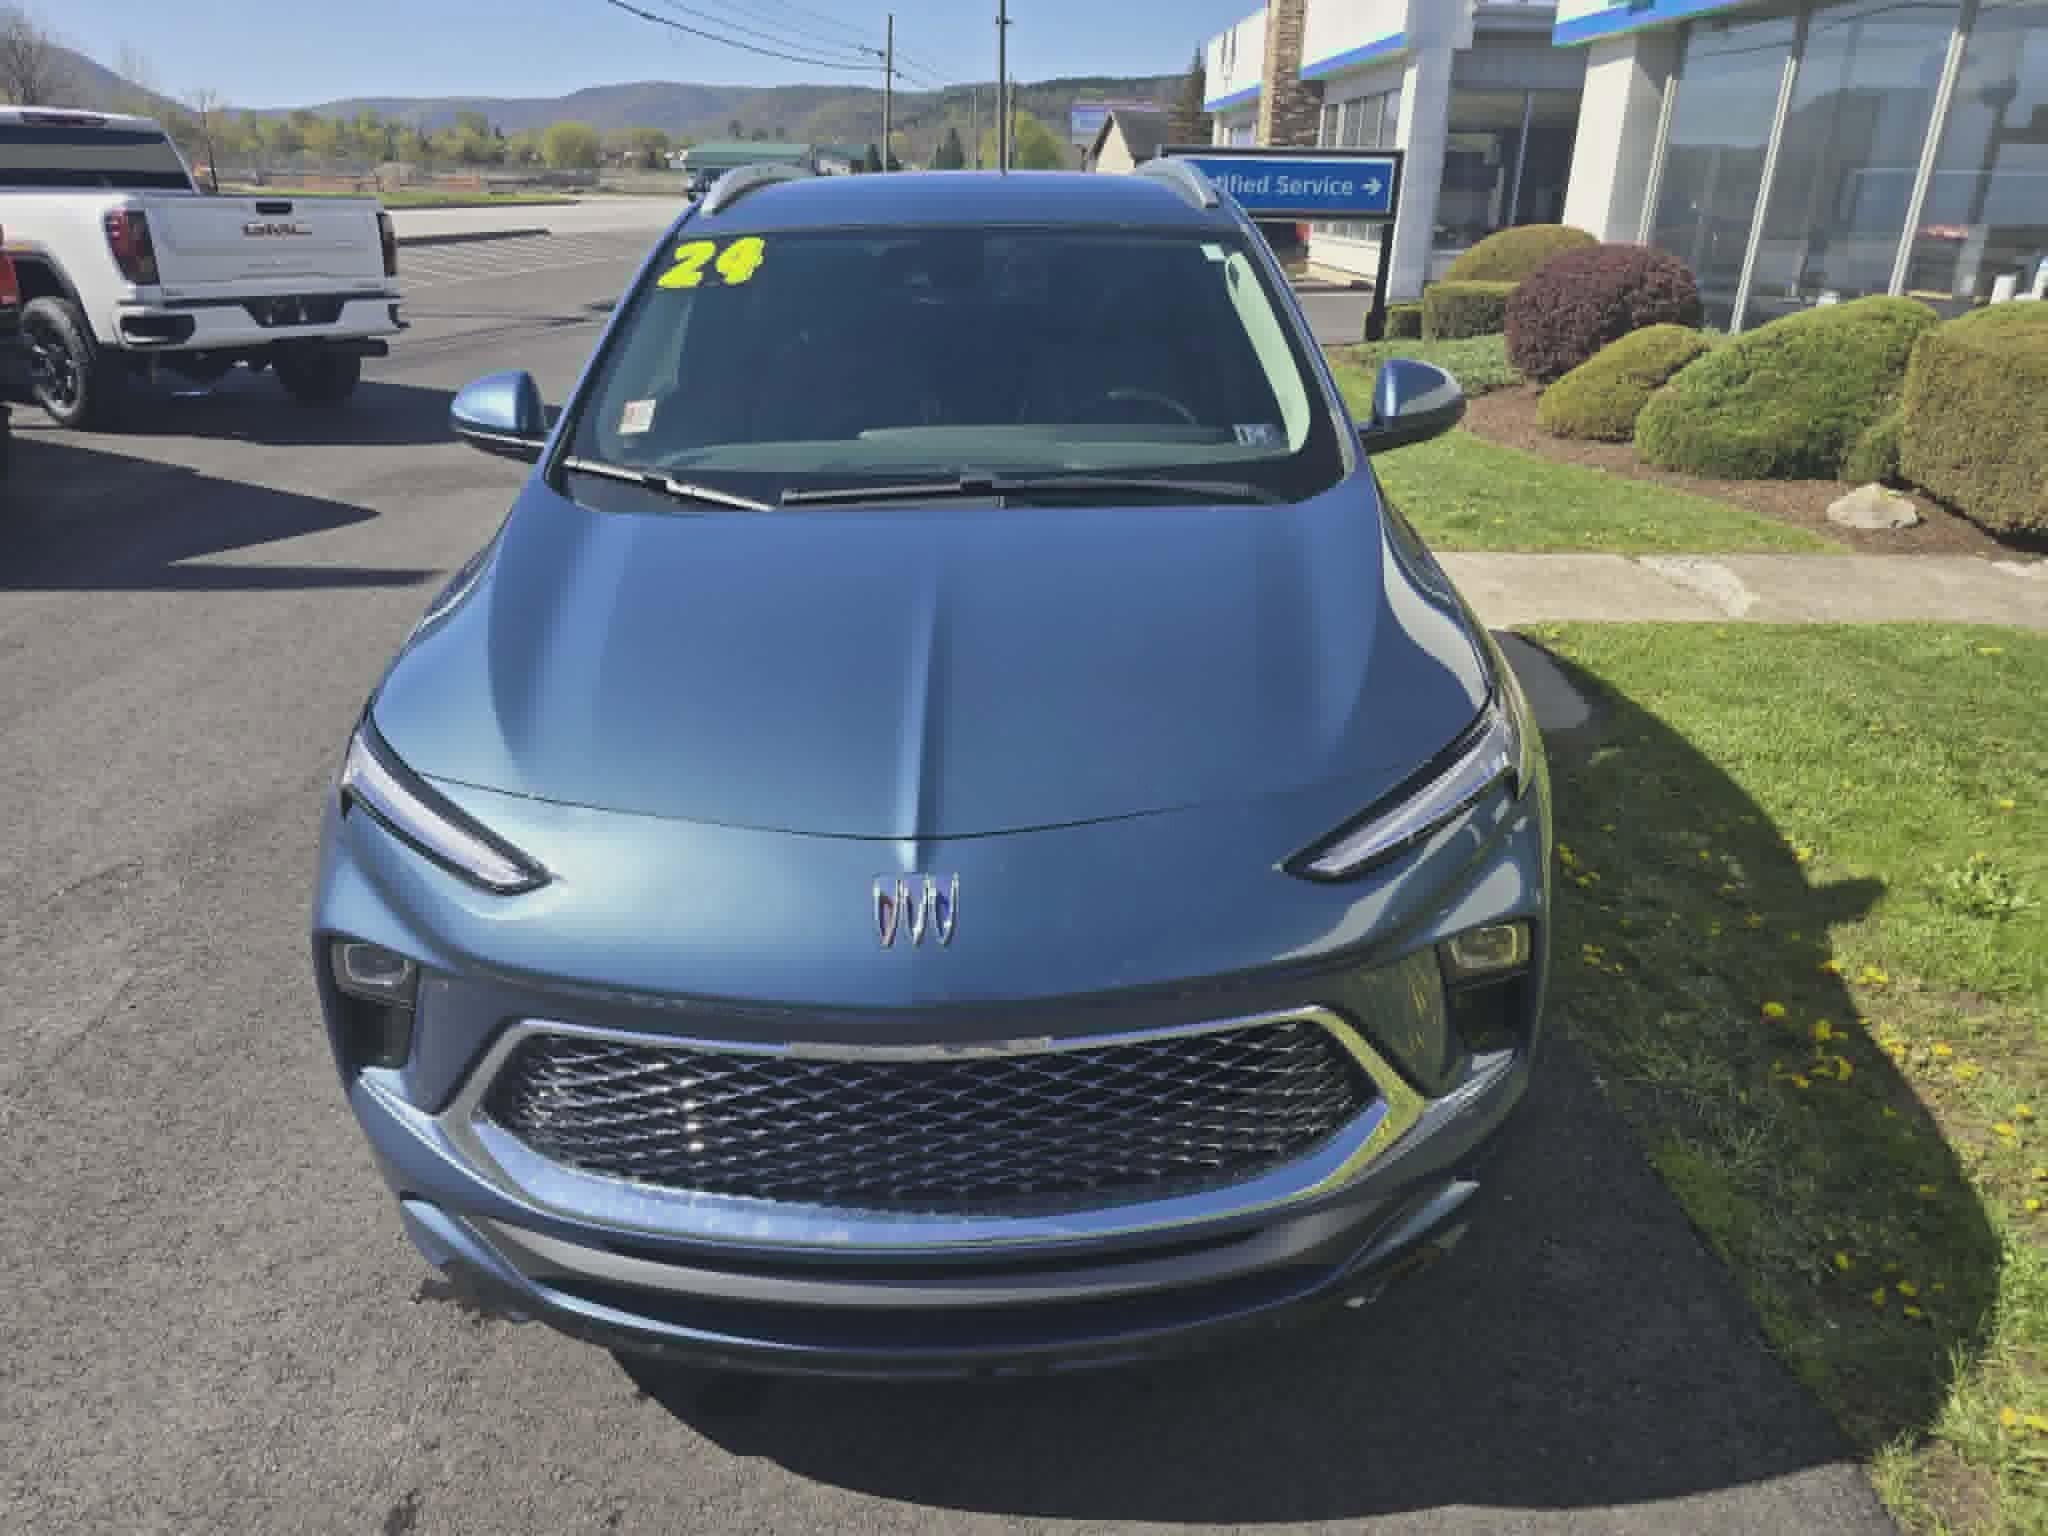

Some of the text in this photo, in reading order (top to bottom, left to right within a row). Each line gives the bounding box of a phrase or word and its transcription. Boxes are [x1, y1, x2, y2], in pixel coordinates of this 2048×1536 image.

[1277, 175, 1353, 196] Service
[241, 223, 312, 239] GMC
[656, 236, 767, 288] 24
